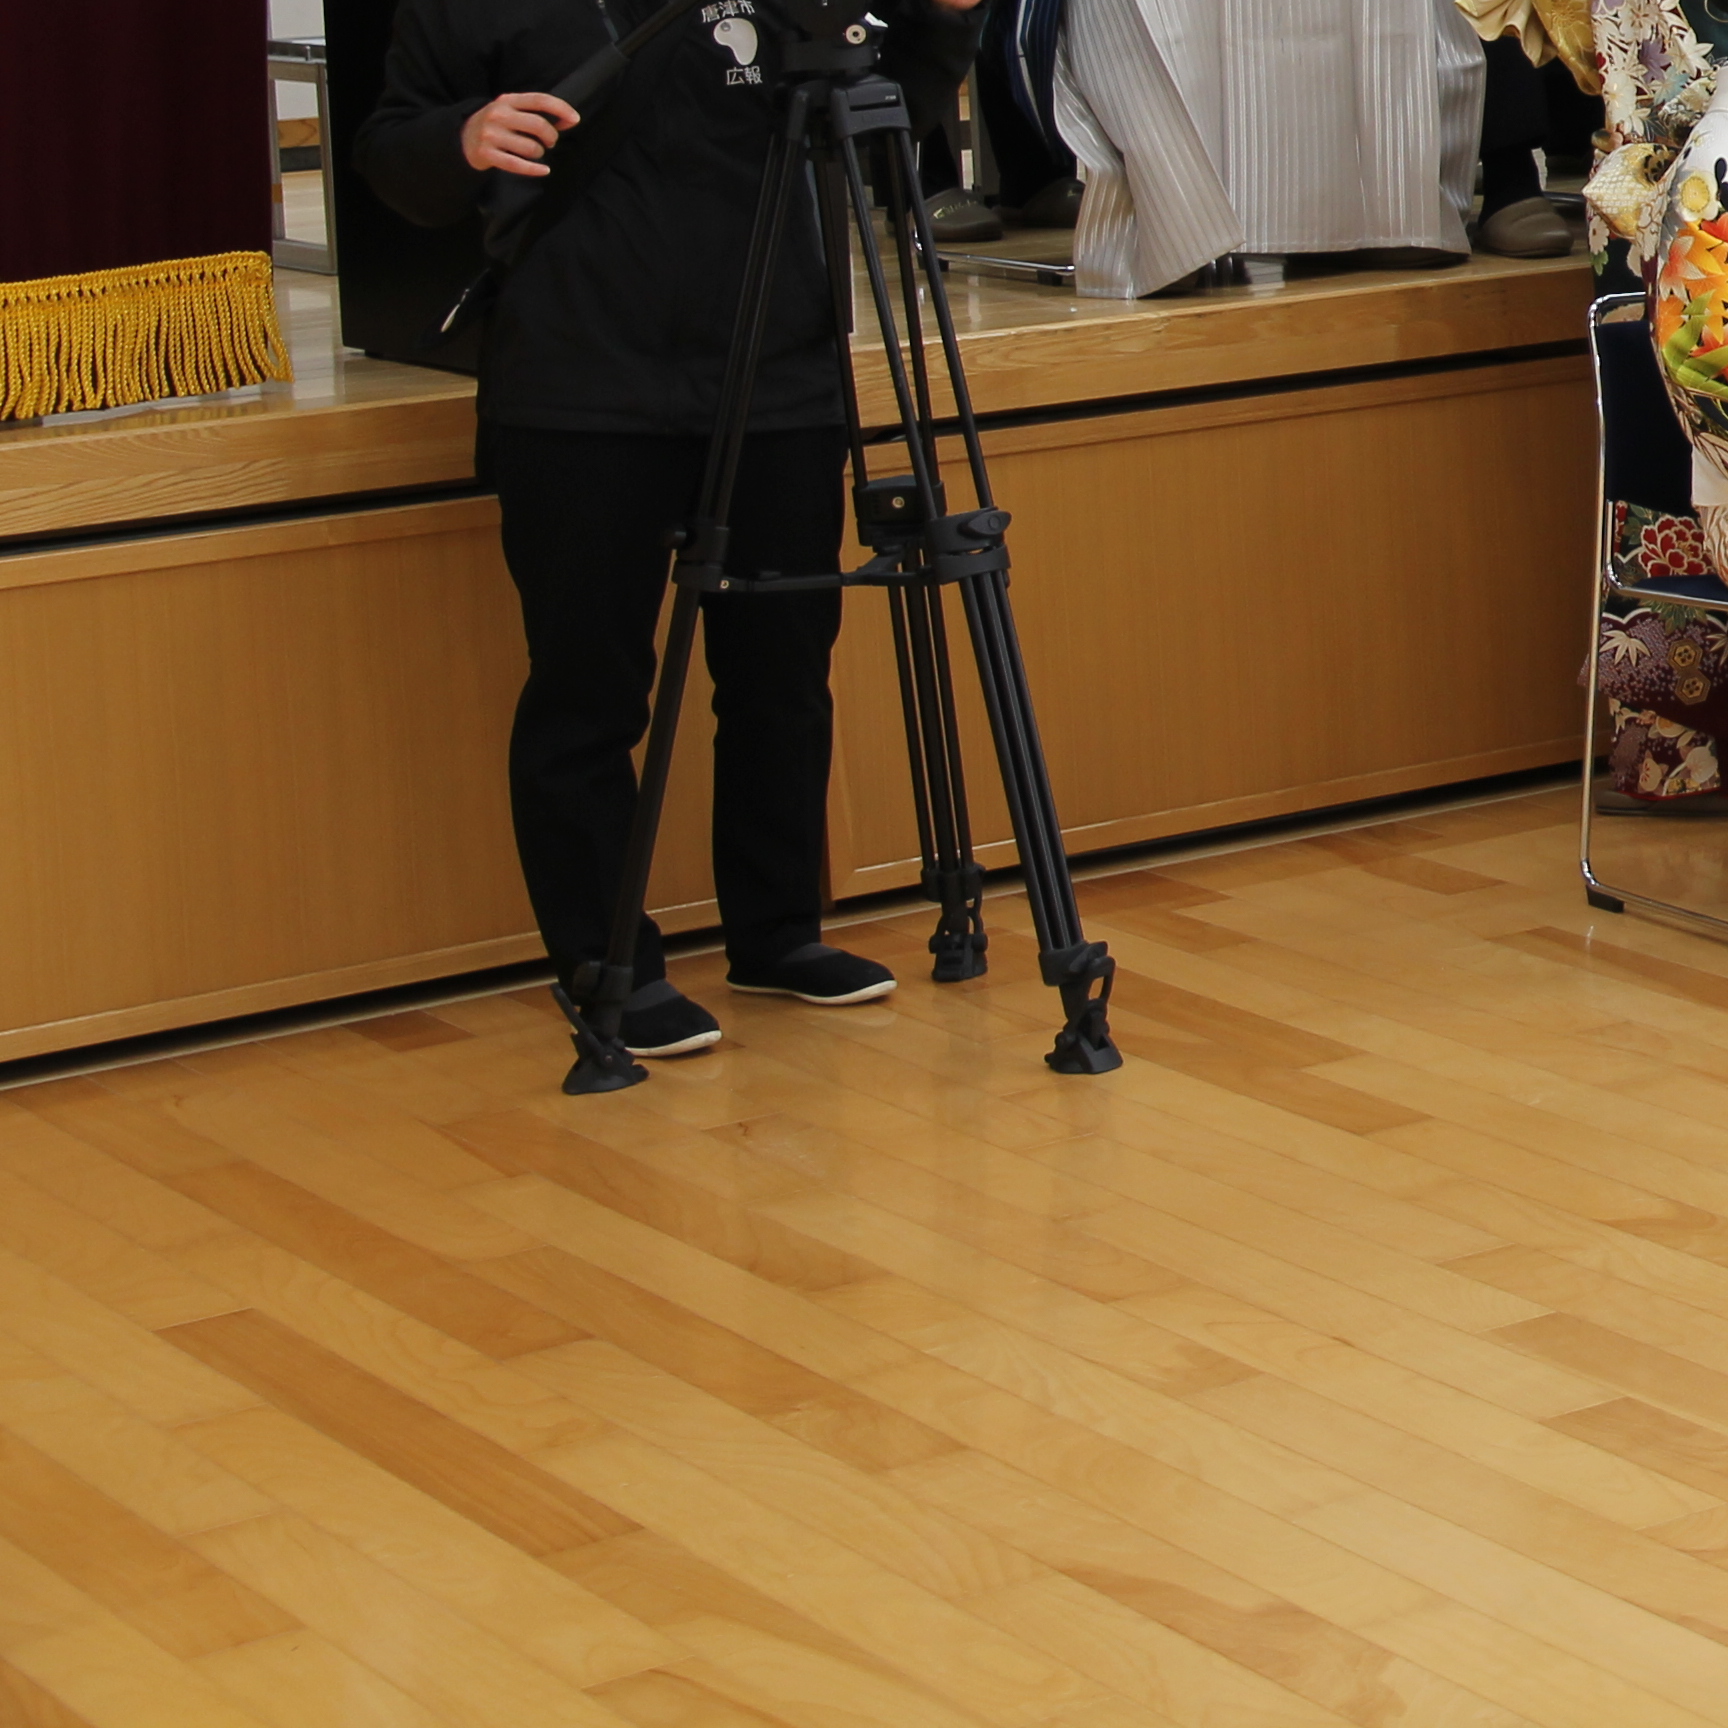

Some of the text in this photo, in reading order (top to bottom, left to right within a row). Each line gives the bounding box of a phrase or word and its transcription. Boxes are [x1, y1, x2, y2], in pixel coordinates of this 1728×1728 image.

[701, 0, 756, 23] 唐津市
[726, 65, 763, 86] 広報
